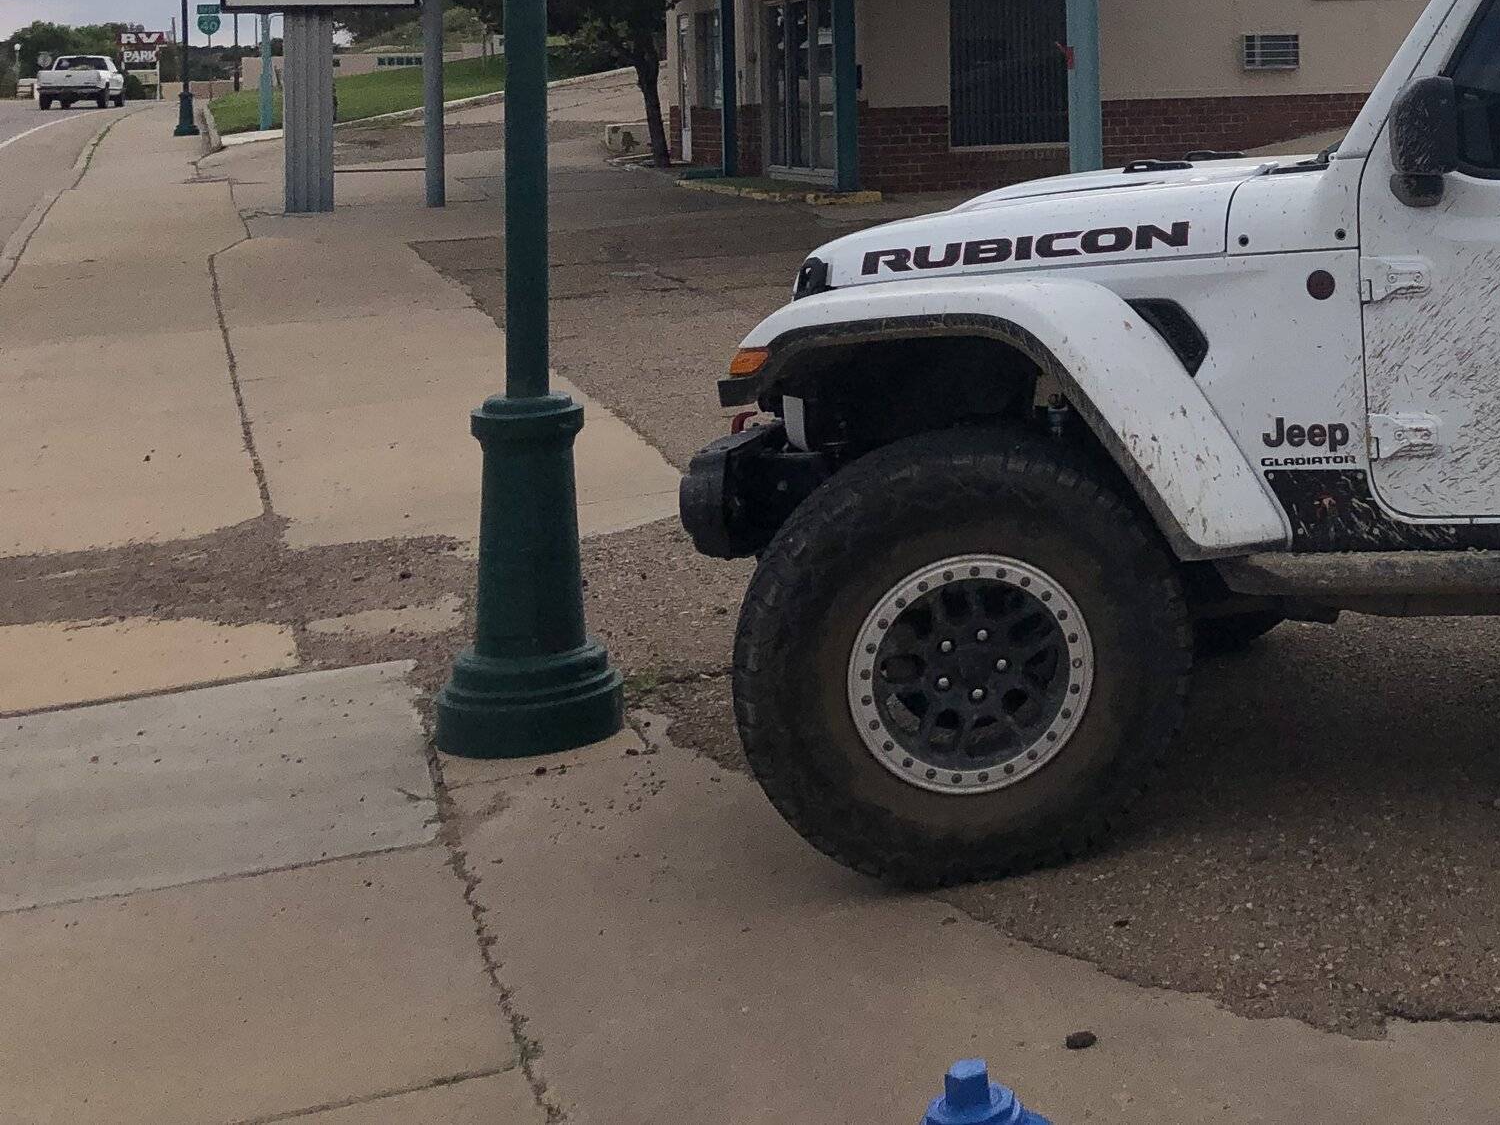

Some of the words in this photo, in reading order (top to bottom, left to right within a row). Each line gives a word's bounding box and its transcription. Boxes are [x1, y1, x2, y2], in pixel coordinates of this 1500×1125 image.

[121, 33, 160, 43] RV
[123, 50, 157, 63] PARK
[861, 221, 1190, 276] RUBICON
[1262, 417, 1349, 452] Jeep
[1260, 455, 1357, 467] GLADIATOR
